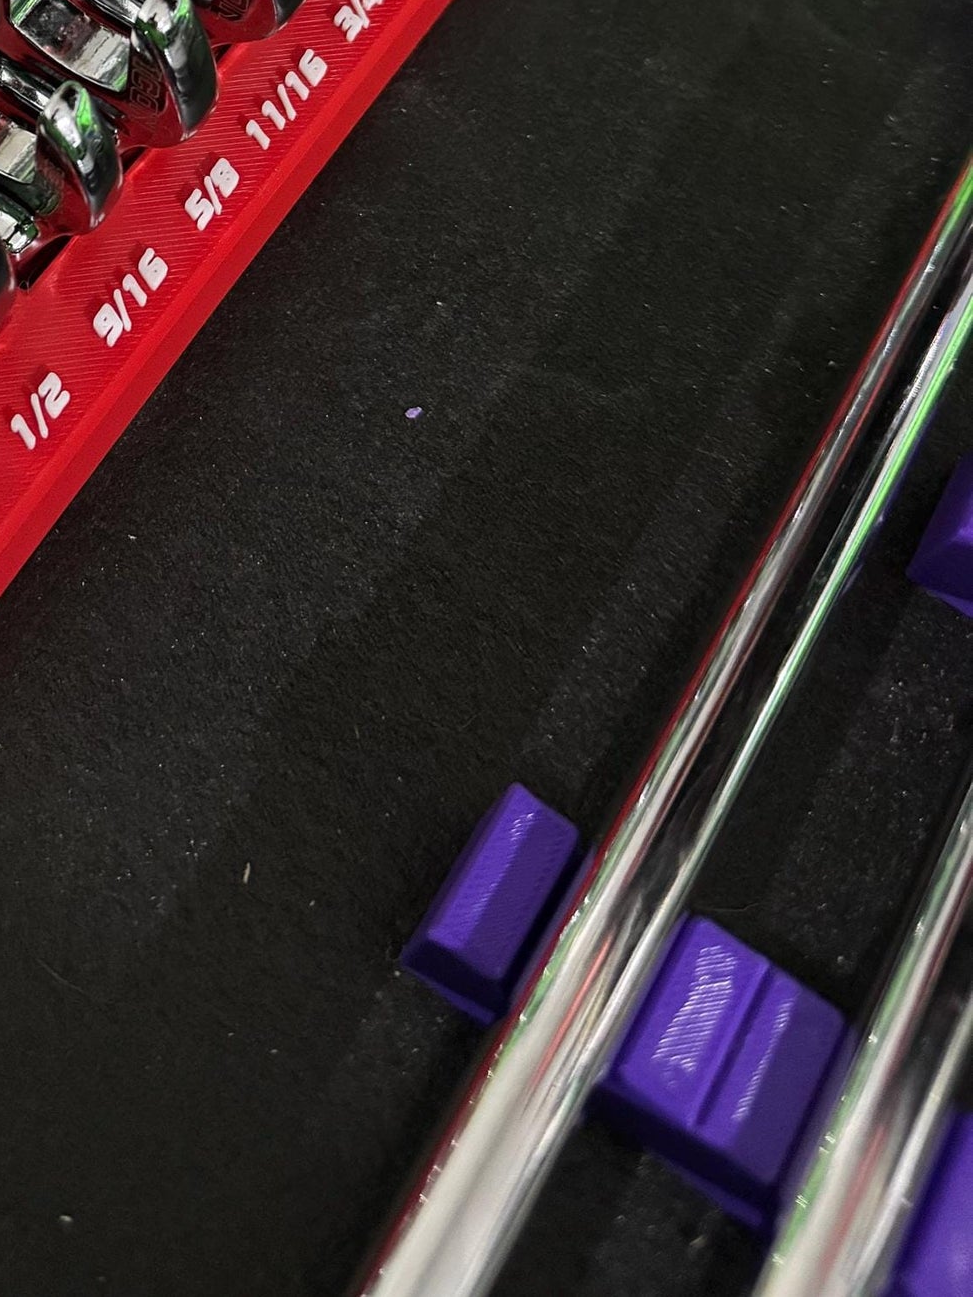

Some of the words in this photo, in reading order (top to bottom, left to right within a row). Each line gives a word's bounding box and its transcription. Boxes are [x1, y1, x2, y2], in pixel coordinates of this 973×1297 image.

[245, 48, 328, 150] 11/16
[184, 157, 240, 232] 5/8
[92, 247, 169, 347] 9/16
[10, 372, 71, 450] 1/2
